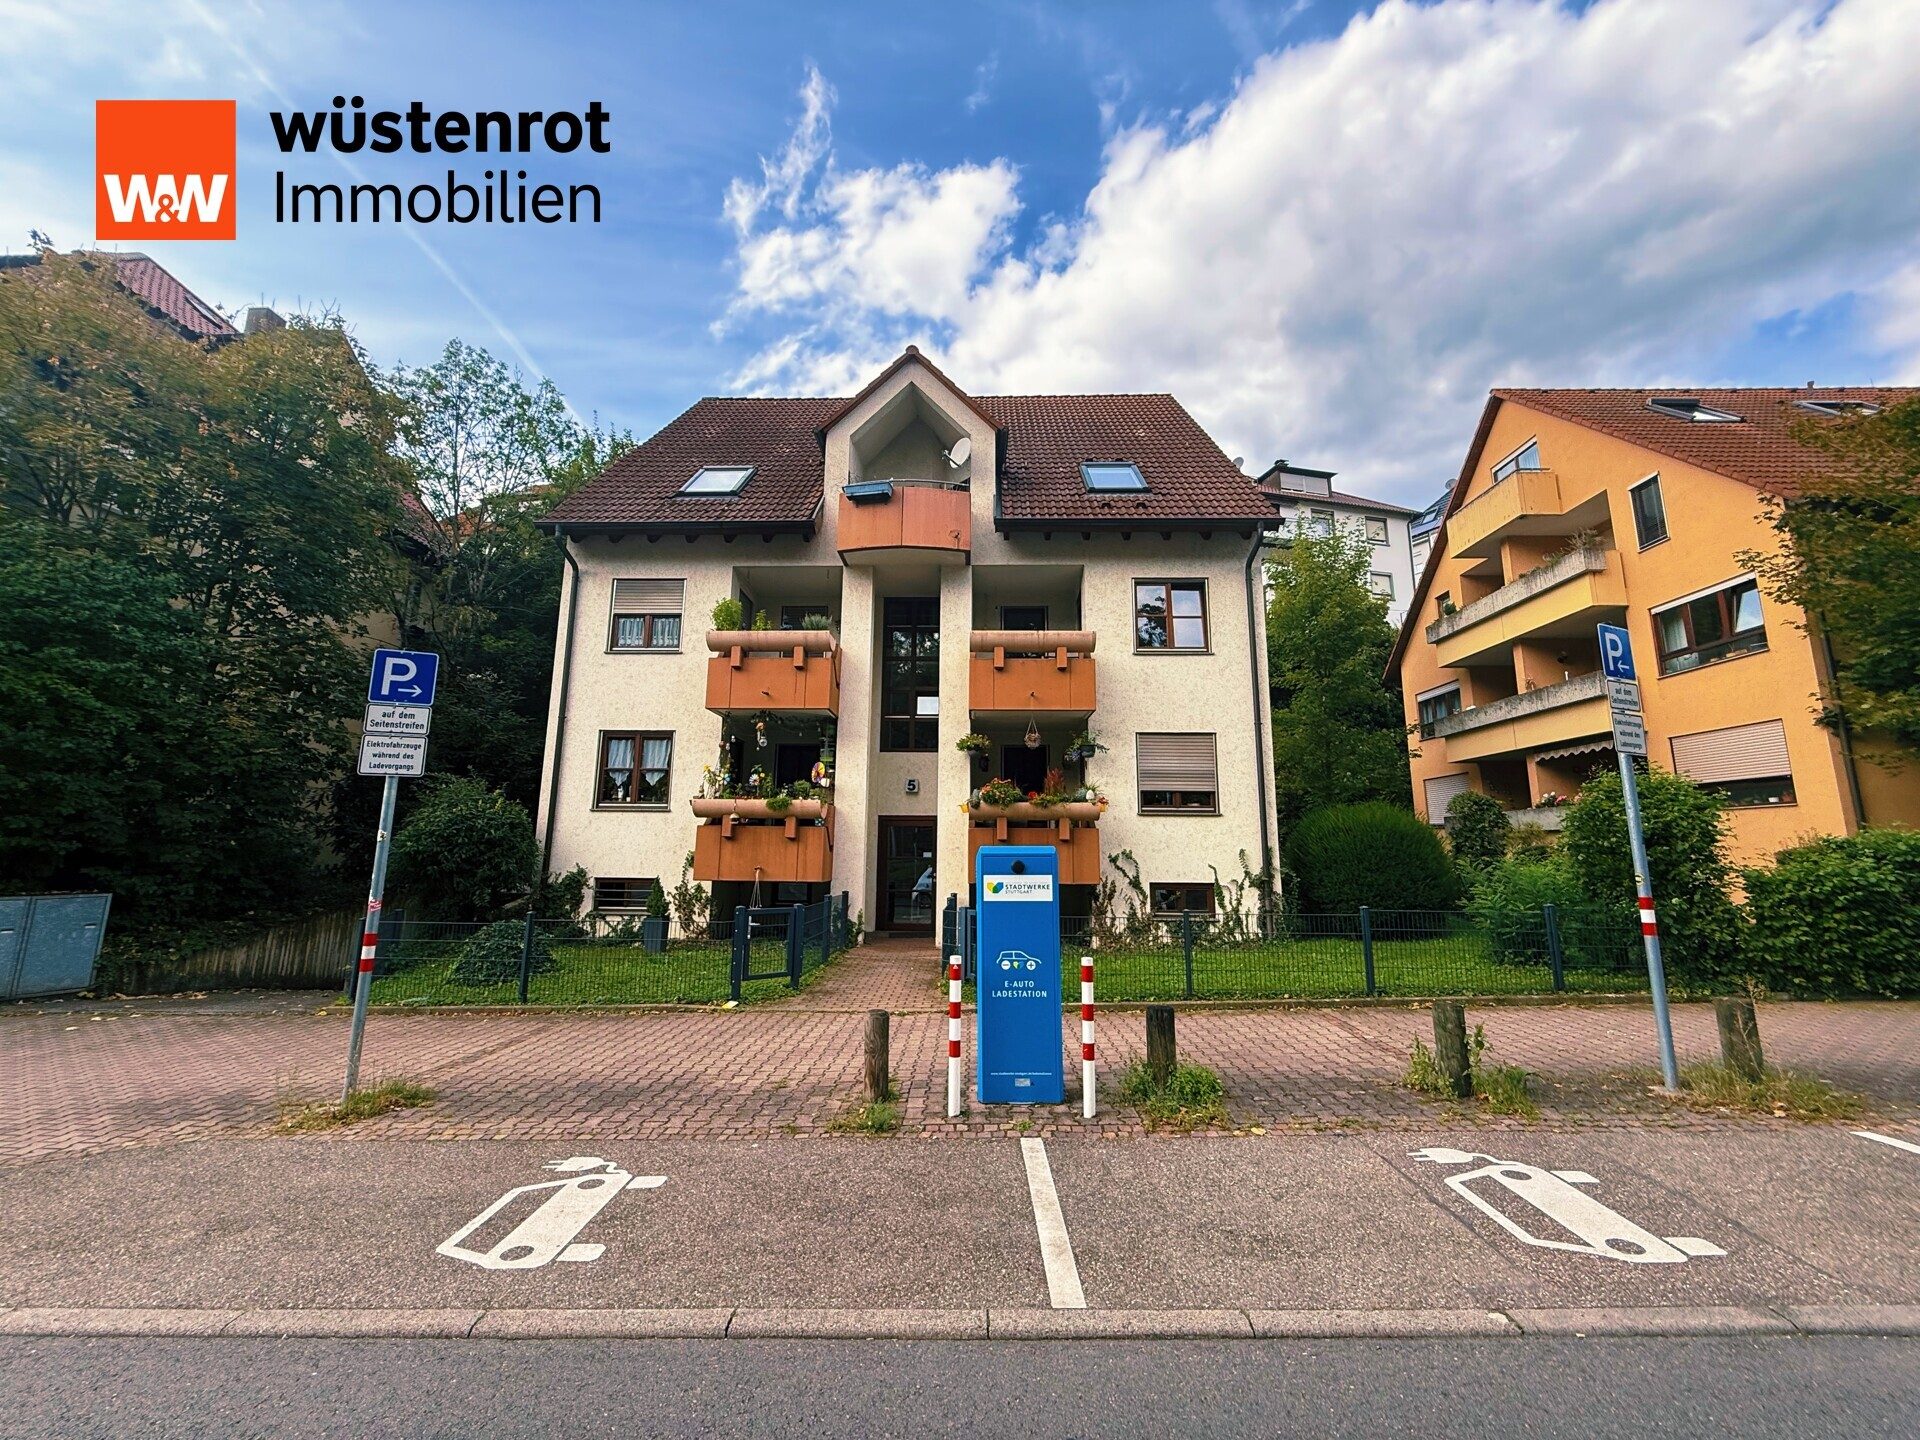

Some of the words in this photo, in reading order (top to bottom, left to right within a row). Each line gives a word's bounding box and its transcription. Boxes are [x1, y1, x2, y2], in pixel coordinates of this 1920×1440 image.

[1604, 632, 1623, 671] P
[381, 657, 417, 696] P
[382, 710, 395, 719] auf
[398, 710, 416, 720] dem
[369, 719, 425, 730] Seitenstreifen
[366, 740, 422, 750] Elektrofahrzeuge
[371, 750, 400, 759] während
[402, 751, 414, 760] des
[368, 761, 414, 771] Ladevorgangs
[907, 779, 916, 791] 5
[1004, 980, 1035, 988] E-AUTO
[991, 990, 1048, 998] LADESTATION
